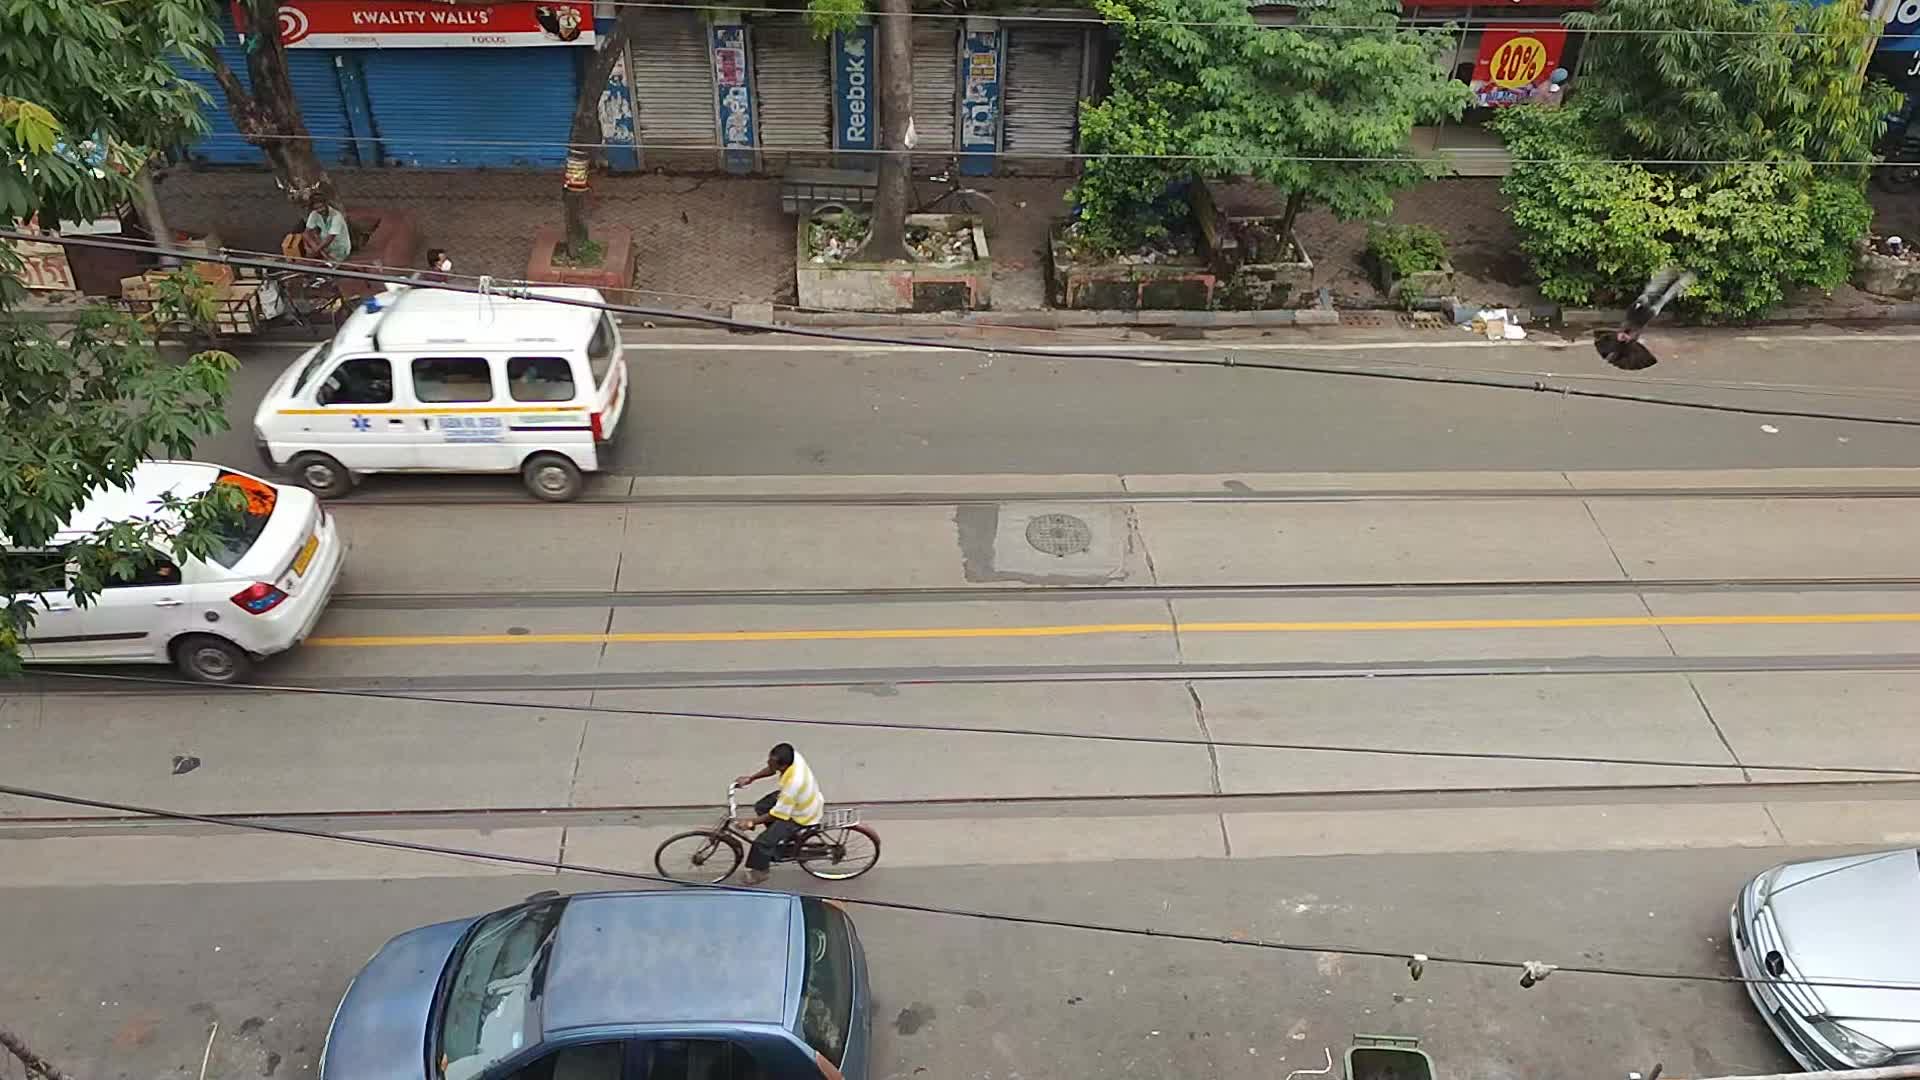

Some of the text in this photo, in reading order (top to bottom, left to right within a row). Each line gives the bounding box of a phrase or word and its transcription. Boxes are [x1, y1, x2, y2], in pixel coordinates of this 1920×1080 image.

[353, 10, 489, 24] KWALITY WALL'S
[1496, 44, 1540, 81] 20%
[845, 58, 865, 142] Reebok
